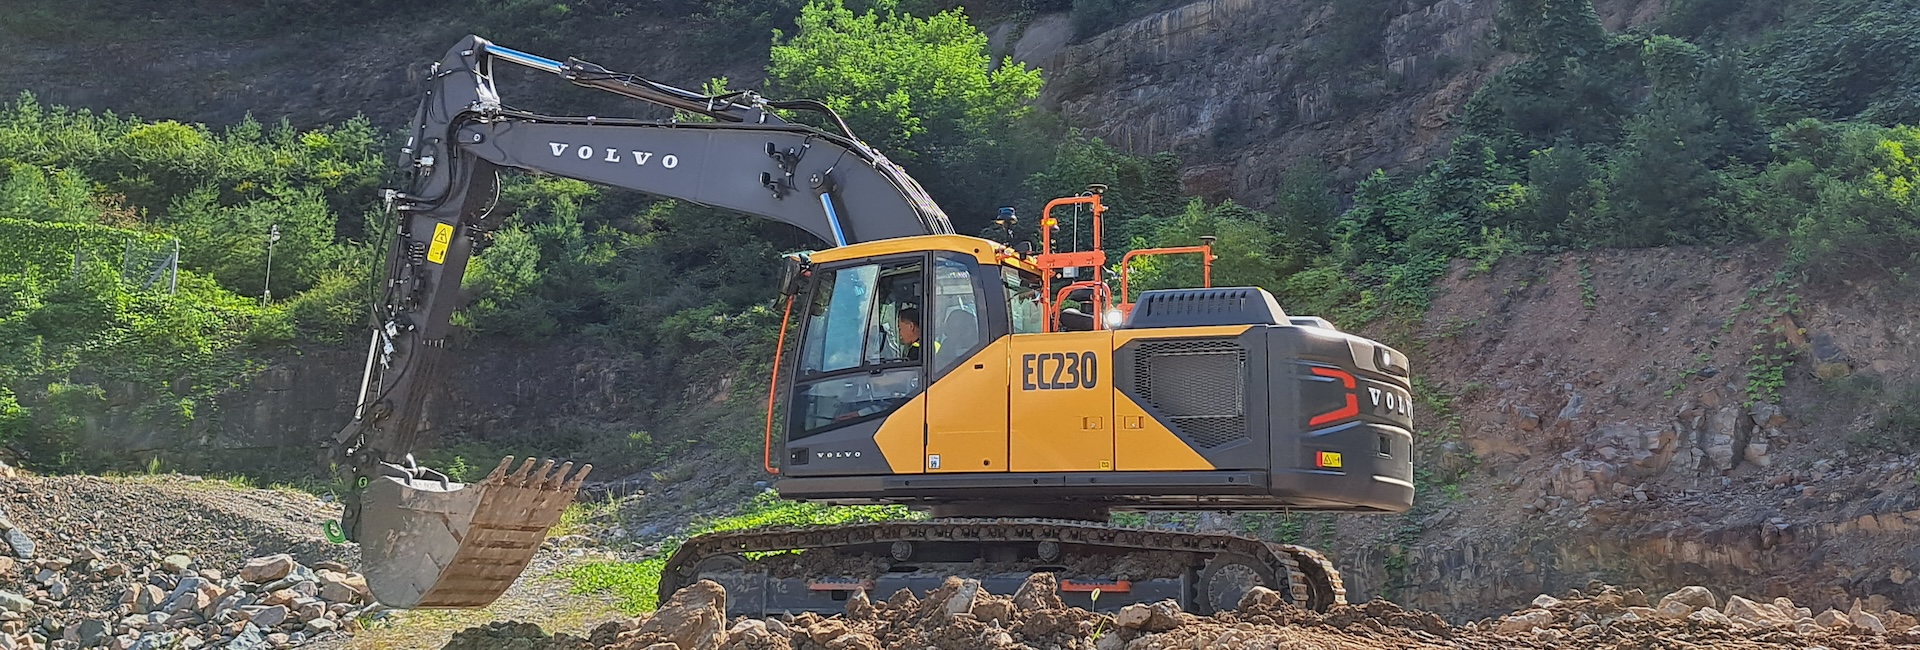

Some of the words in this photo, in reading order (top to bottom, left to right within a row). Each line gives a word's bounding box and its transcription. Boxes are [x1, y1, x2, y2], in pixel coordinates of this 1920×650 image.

[549, 142, 679, 169] VOLVO
[1022, 351, 1098, 391] EC230
[1367, 386, 1413, 419] VOLV
[816, 451, 861, 459] VOLVO
